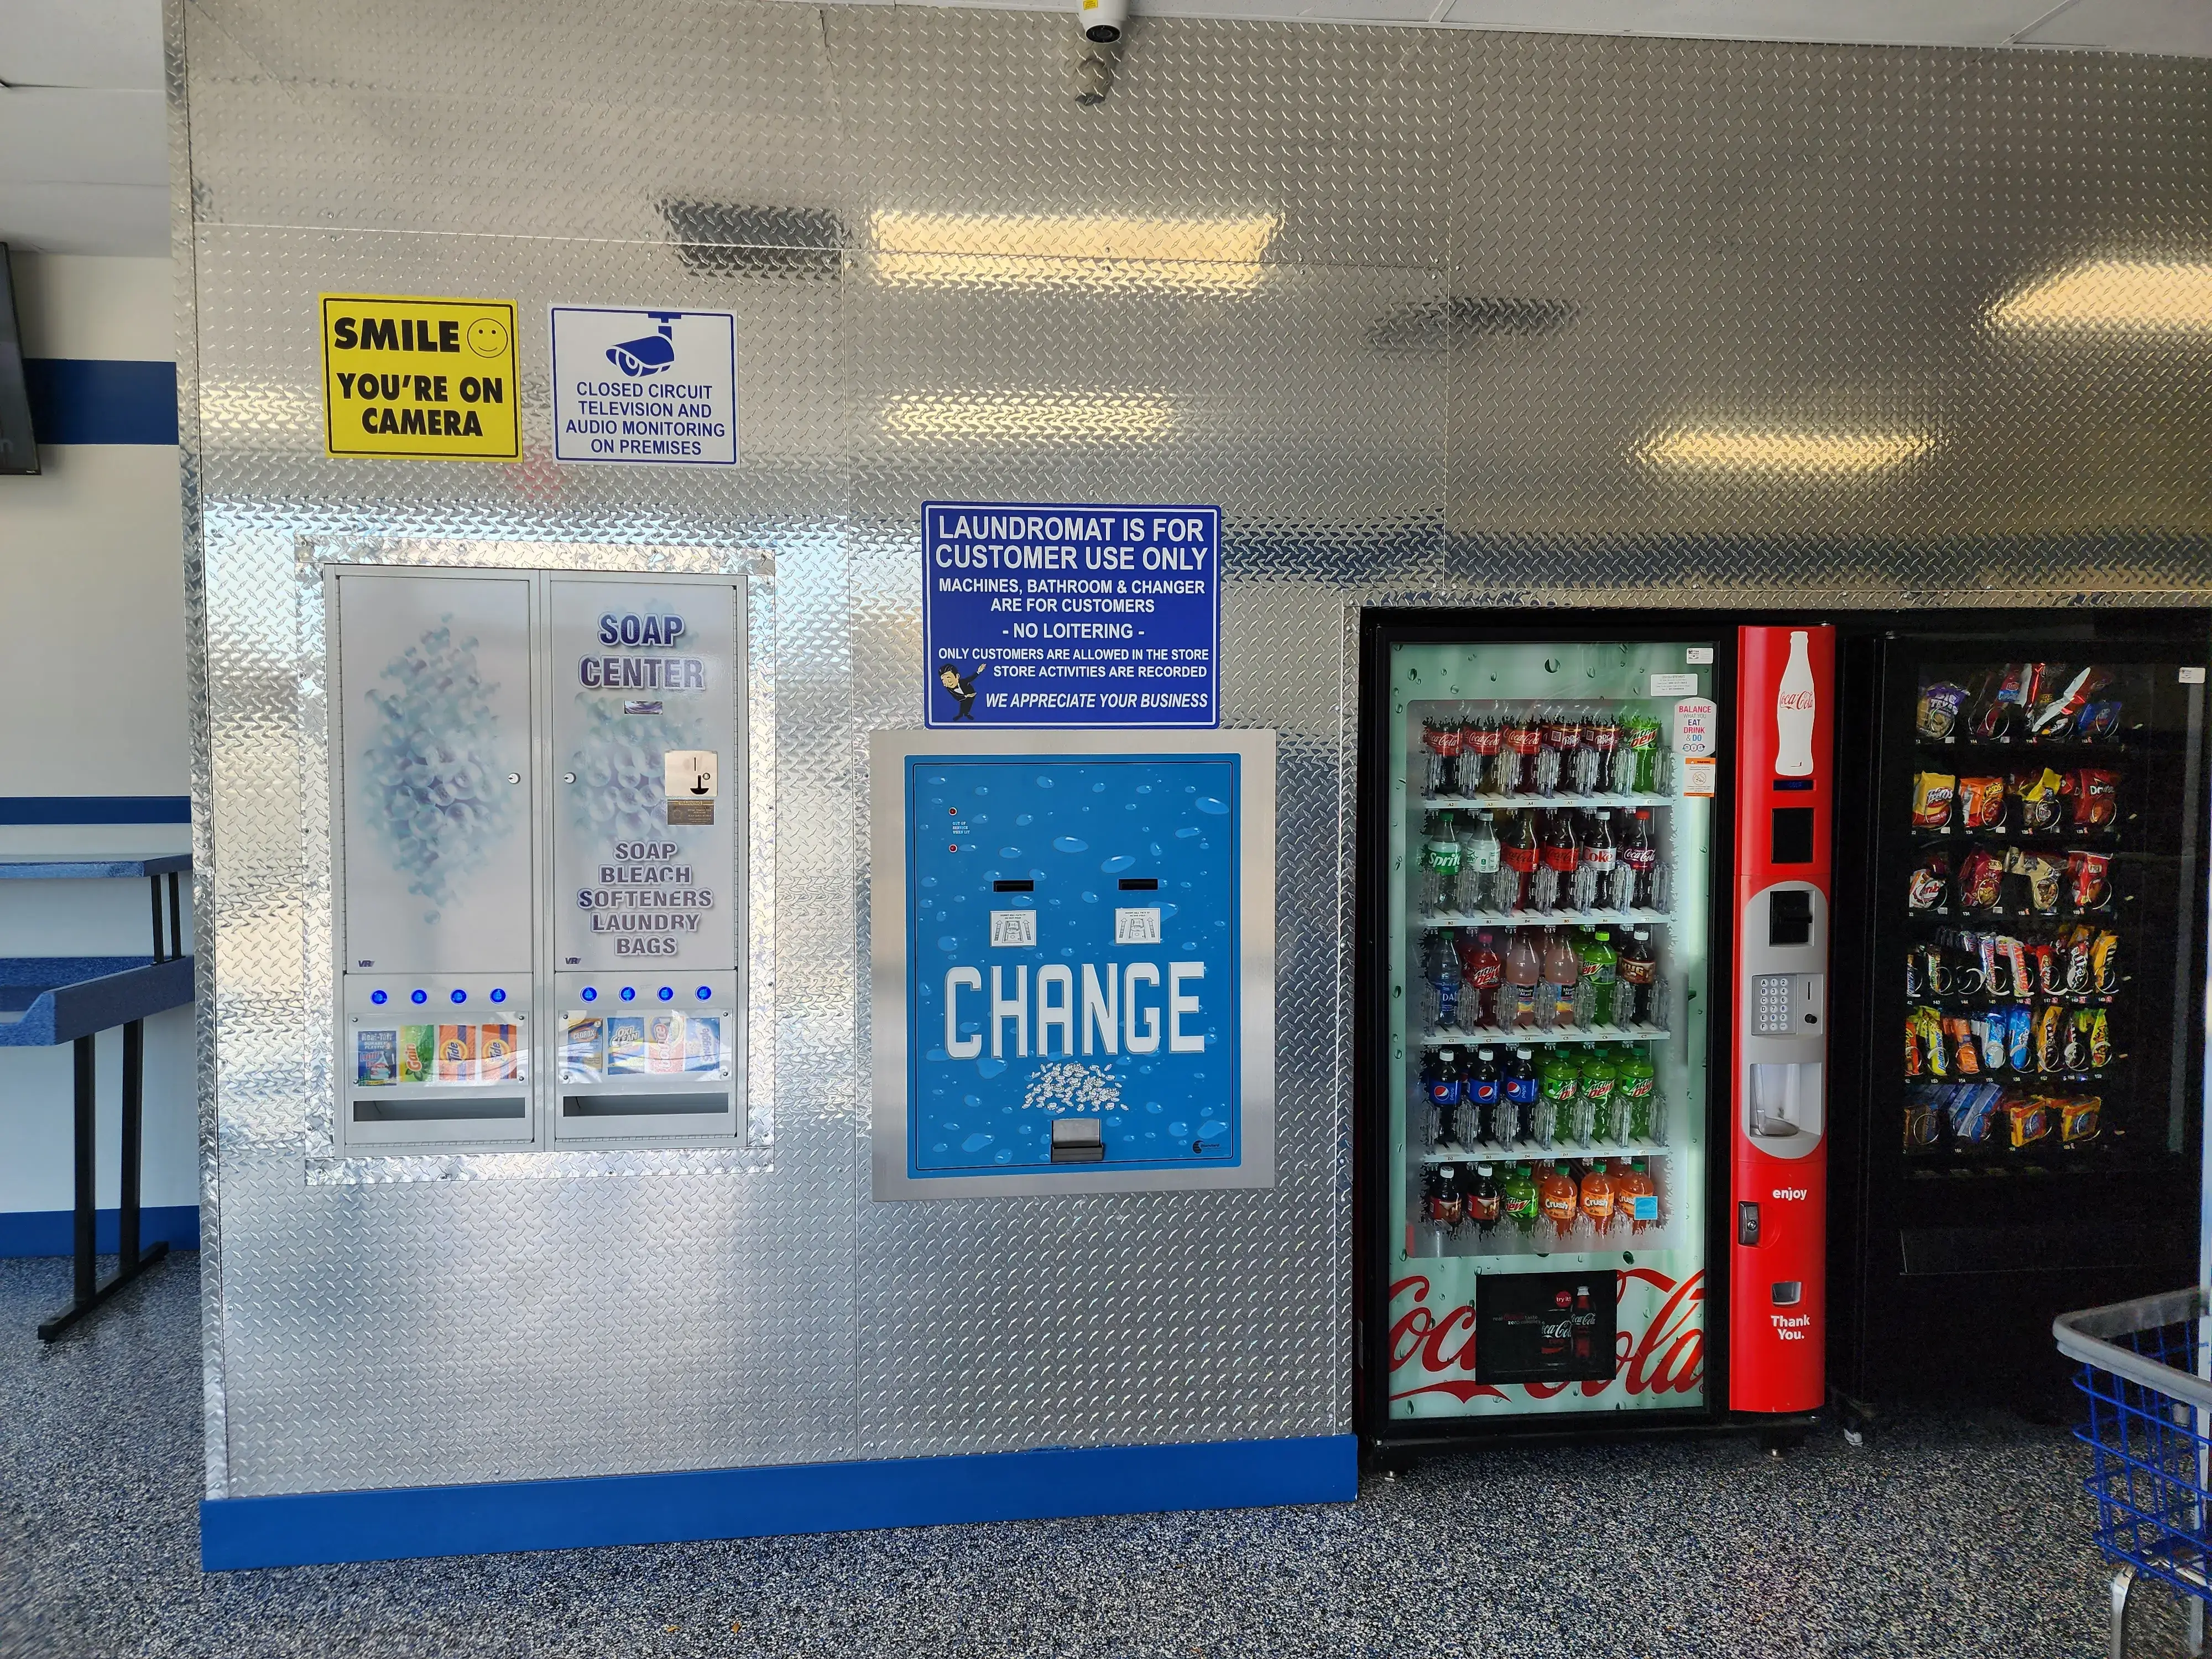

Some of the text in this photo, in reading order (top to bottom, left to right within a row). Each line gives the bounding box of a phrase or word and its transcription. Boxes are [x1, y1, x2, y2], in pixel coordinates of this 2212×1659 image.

[333, 317, 460, 353] SMILE
[336, 372, 504, 404] YOU'RE ON
[576, 382, 713, 399] CLOSED CIRCUIT
[578, 400, 712, 419] TELEVISION AND
[361, 407, 483, 437] CAMERA
[565, 419, 725, 437] AUDIO MONITORING
[591, 439, 701, 456] ON PREMISES
[939, 515, 1204, 542] LAUNDROMAT IS FOR
[935, 544, 1208, 571] CUSTOMER USE ONLY
[939, 578, 1205, 595] MACHINES, BATHROOM & CHANGER
[990, 598, 1155, 613] ARE FOR CUSTOMERS
[599, 614, 684, 645] SOAP
[1013, 623, 1037, 639] NO
[1044, 623, 1133, 639] LOITERING
[938, 648, 1209, 660] ONLY CUSTOMERS ARE ALLOWED IN THE STORE
[580, 656, 704, 688] CENTER
[993, 666, 1207, 678] STORE ACTIVITIES ARE RECORDED
[986, 693, 1208, 708] WE APPRECIATE YOUR BUSINESS
[1780, 691, 1813, 710] Coca-Cola
[615, 843, 676, 859] SOAP
[1583, 848, 1613, 862] Coke
[601, 867, 690, 883] BLEACH
[579, 890, 712, 907] SOFTENERS
[592, 914, 699, 932] LAUNDRY
[617, 938, 675, 954] BAGS
[945, 962, 1204, 1059] CHANGE
[573, 1030, 596, 1040] CLOROX
[617, 1027, 633, 1037] OXI
[406, 1043, 422, 1071] Gain
[447, 1042, 462, 1062] Tide
[1584, 1197, 1608, 1206] Crush
[1773, 1187, 1807, 1201] enjoy
[1545, 1199, 1568, 1209] Crush
[1771, 1314, 1810, 1327] Thank
[1777, 1328, 1804, 1340] You.
